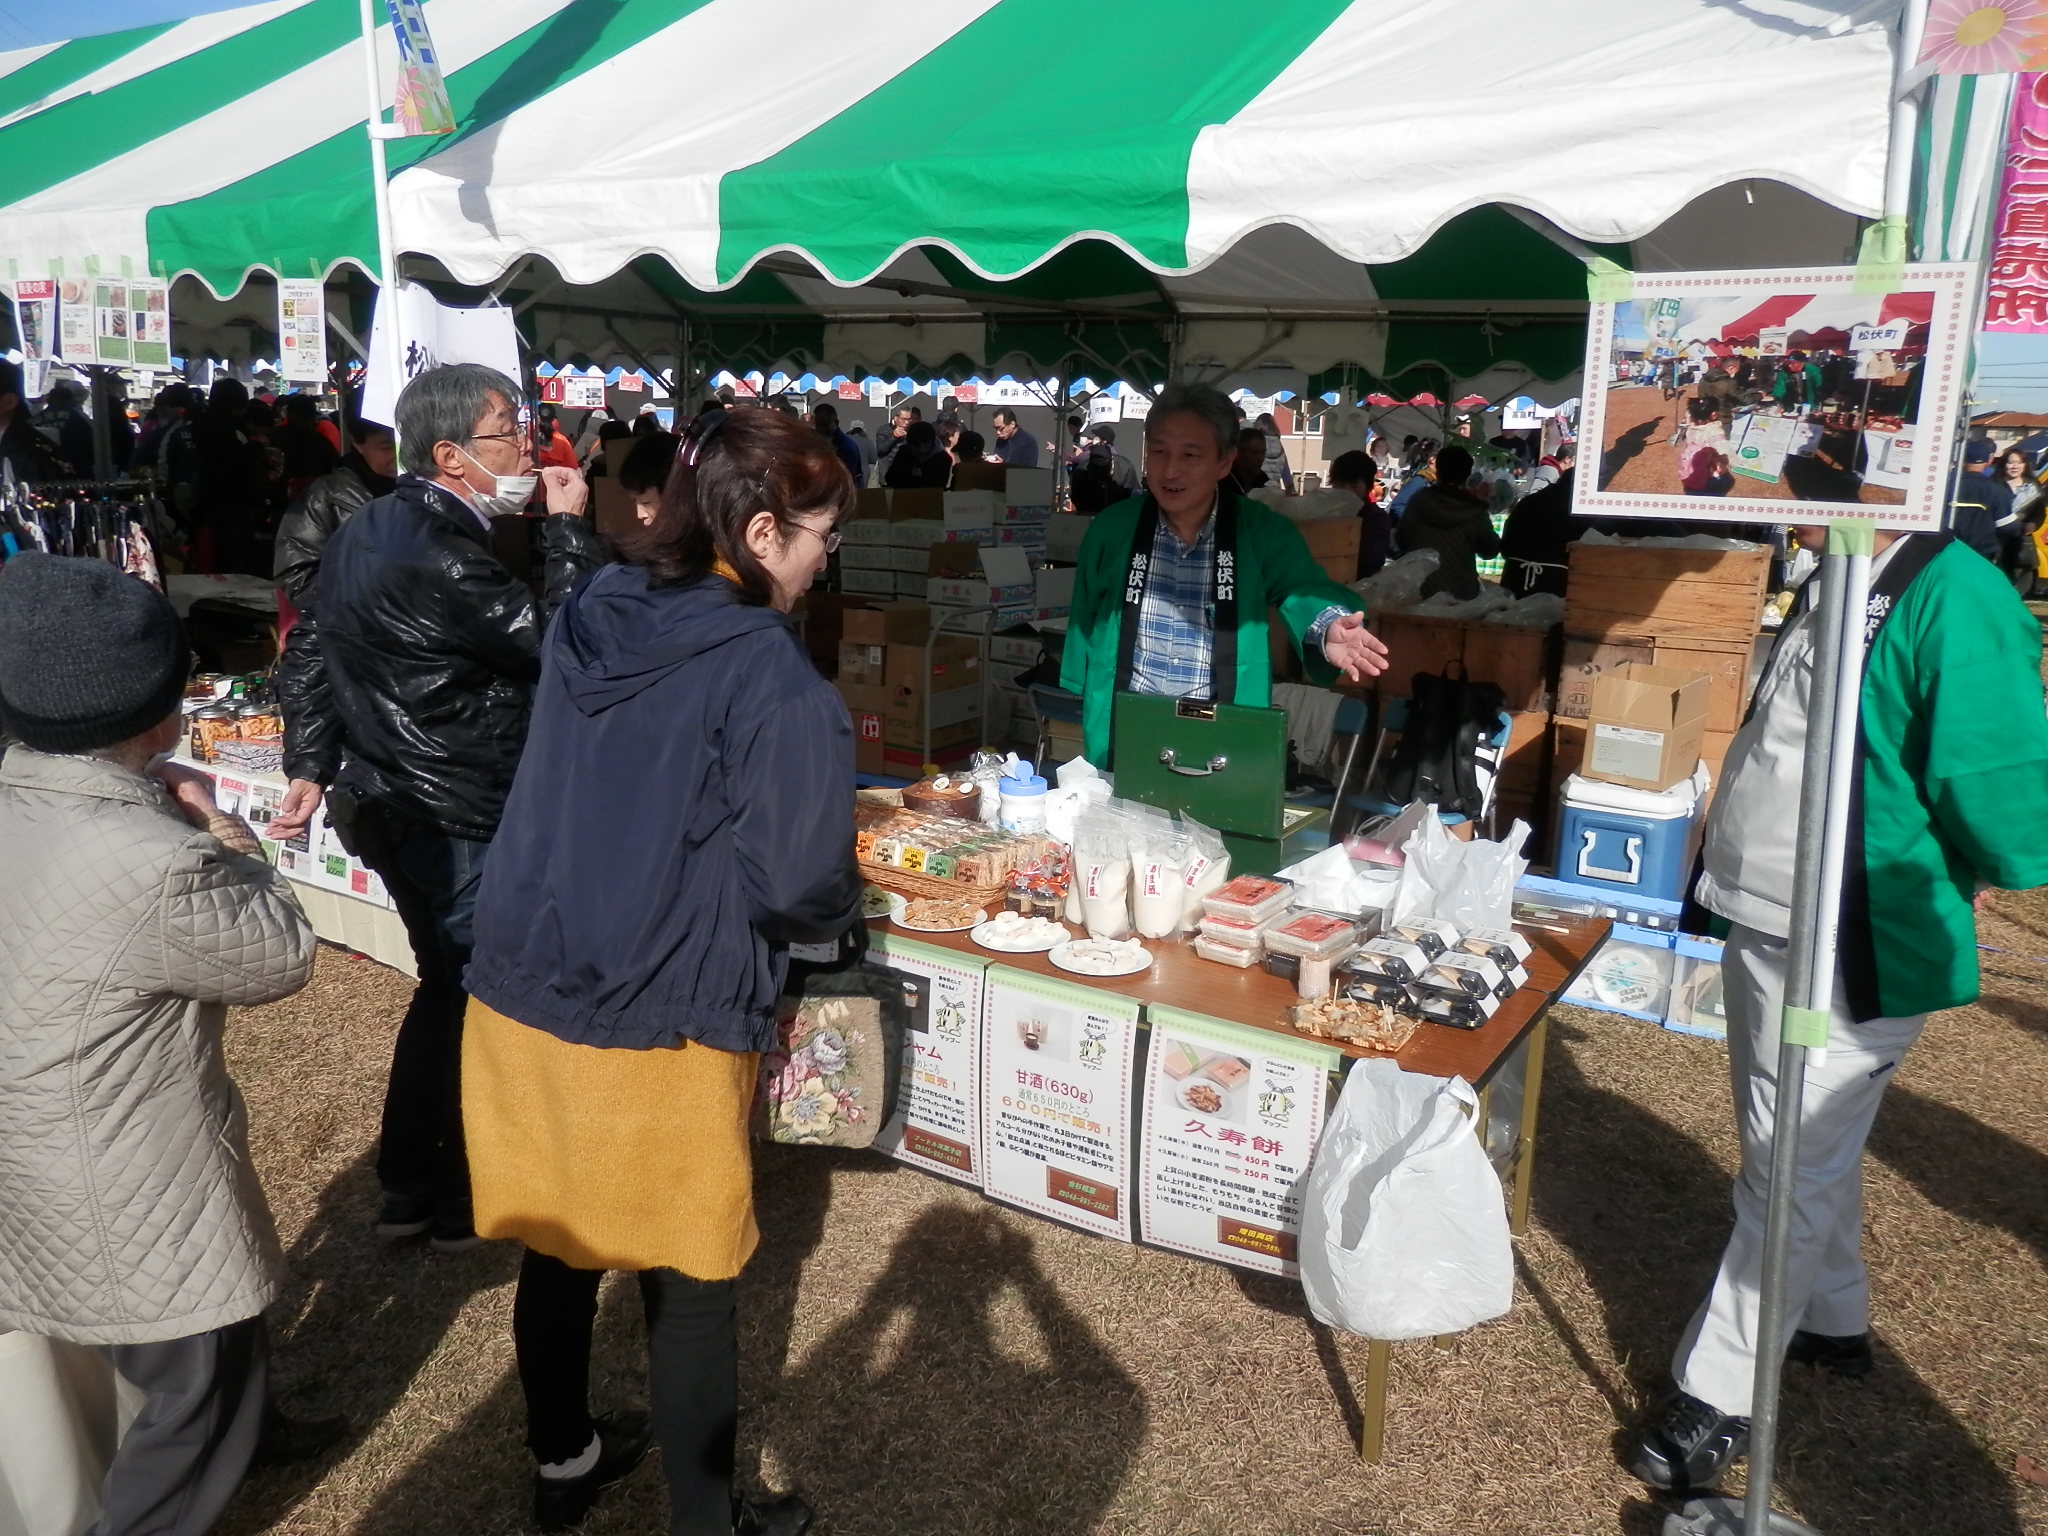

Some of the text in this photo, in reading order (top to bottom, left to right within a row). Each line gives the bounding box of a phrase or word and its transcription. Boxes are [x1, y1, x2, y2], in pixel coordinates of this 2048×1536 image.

[1857, 328, 1898, 342] 松伏町
[1125, 553, 1148, 605] 松伏町
[1216, 550, 1234, 600] 松伏町
[1184, 1119, 1285, 1157] 久寿餅
